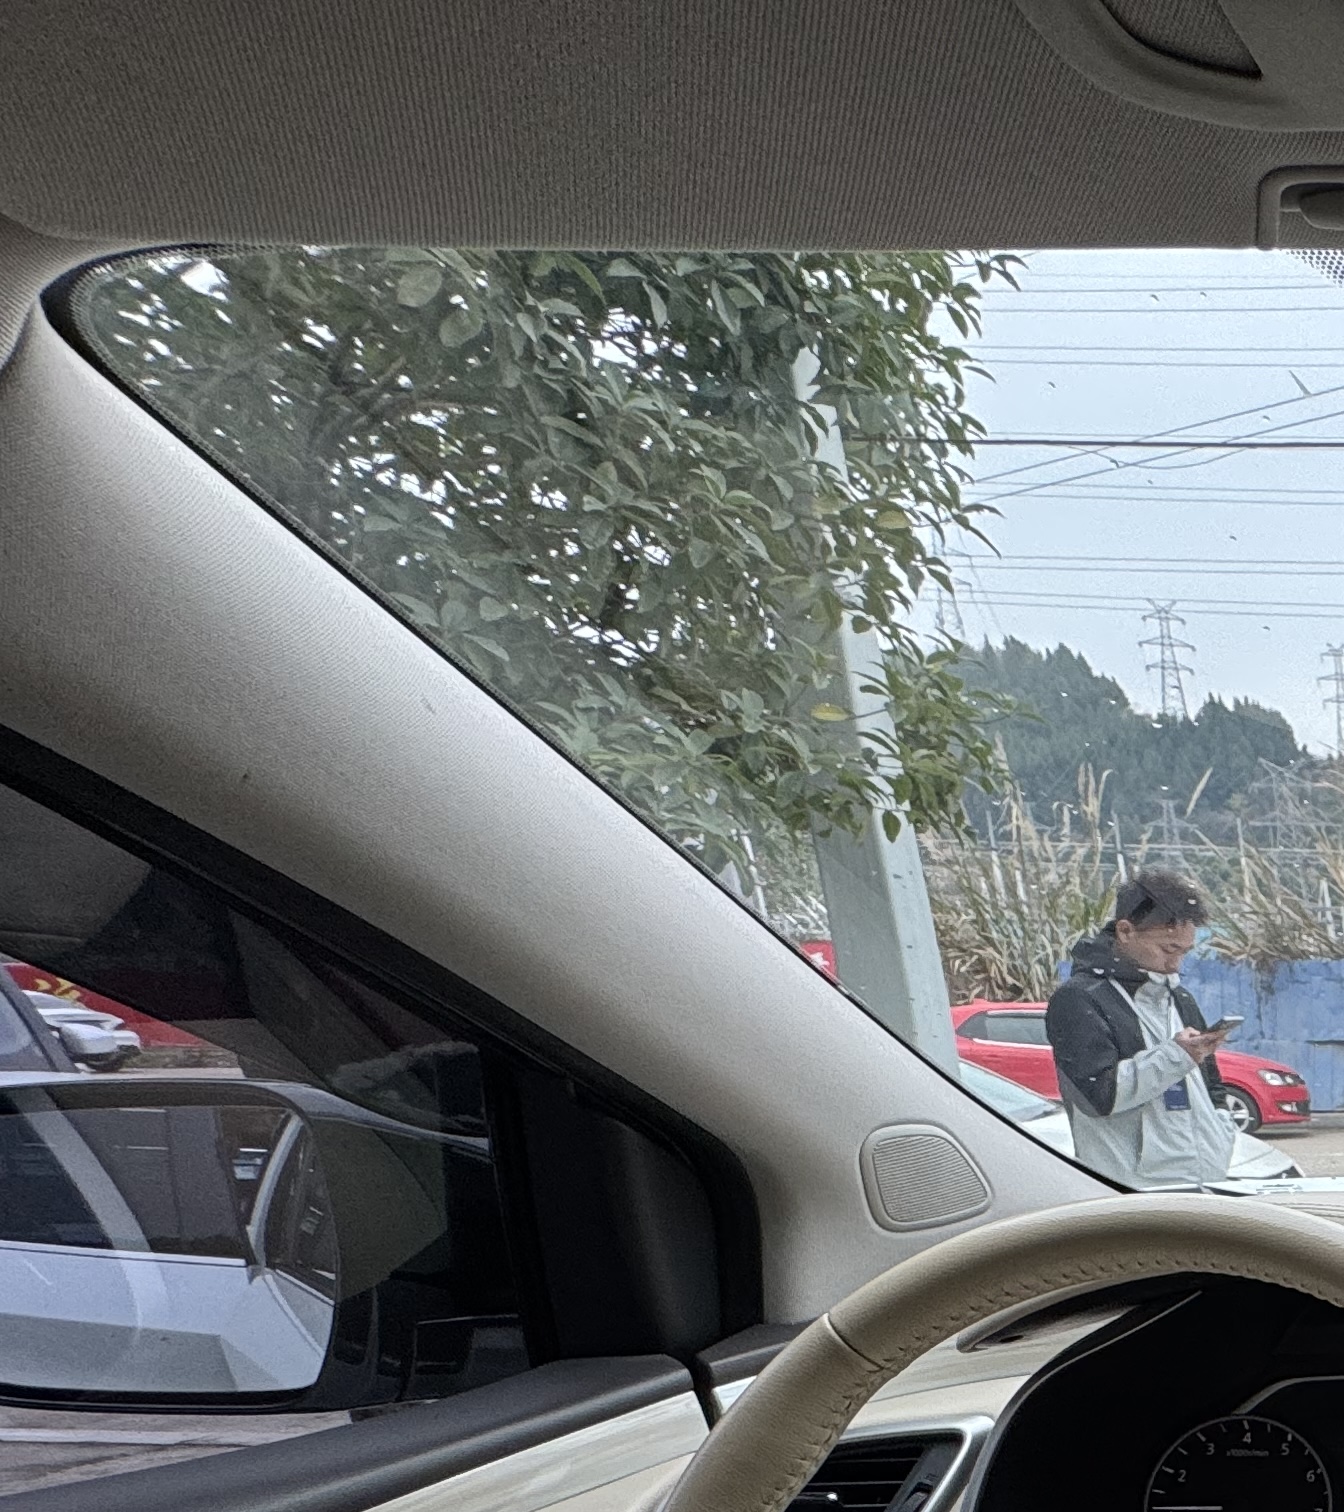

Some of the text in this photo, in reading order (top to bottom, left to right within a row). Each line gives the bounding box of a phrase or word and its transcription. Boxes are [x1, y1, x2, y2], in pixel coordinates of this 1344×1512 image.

[1243, 1433, 1252, 1444] 4
[1206, 1443, 1215, 1455] 3
[1281, 1443, 1290, 1455] 5
[1177, 1470, 1186, 1482] 2
[1306, 1470, 1315, 1482] 6
